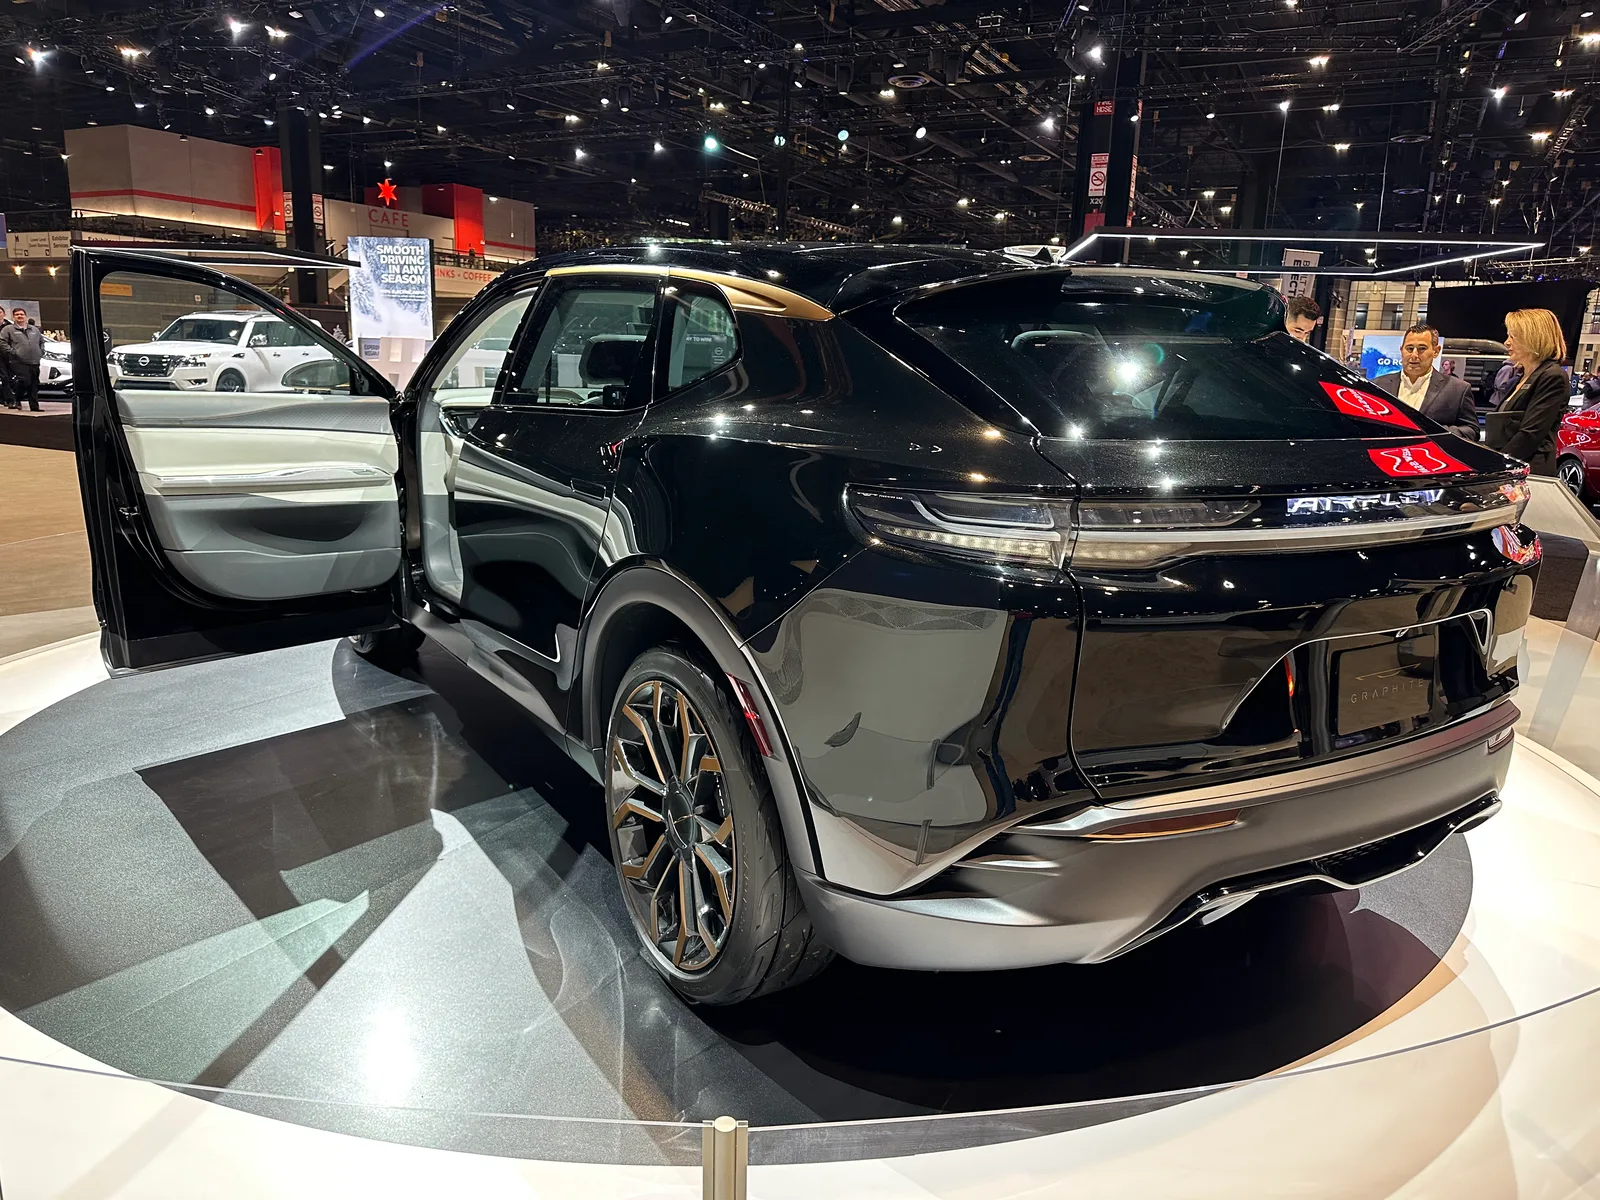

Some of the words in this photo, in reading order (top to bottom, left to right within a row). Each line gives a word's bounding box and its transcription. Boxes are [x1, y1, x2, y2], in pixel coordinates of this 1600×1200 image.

[368, 209, 409, 228] CAFE
[376, 245, 424, 256] SMOOTH
[380, 255, 425, 265] DRIVING
[388, 264, 399, 274] IN
[402, 265, 425, 275] ANY
[381, 274, 425, 284] SEASON
[463, 271, 492, 281] COFFEE
[1377, 358, 1390, 366] GO
[1350, 679, 1424, 704] GRAPHITE
